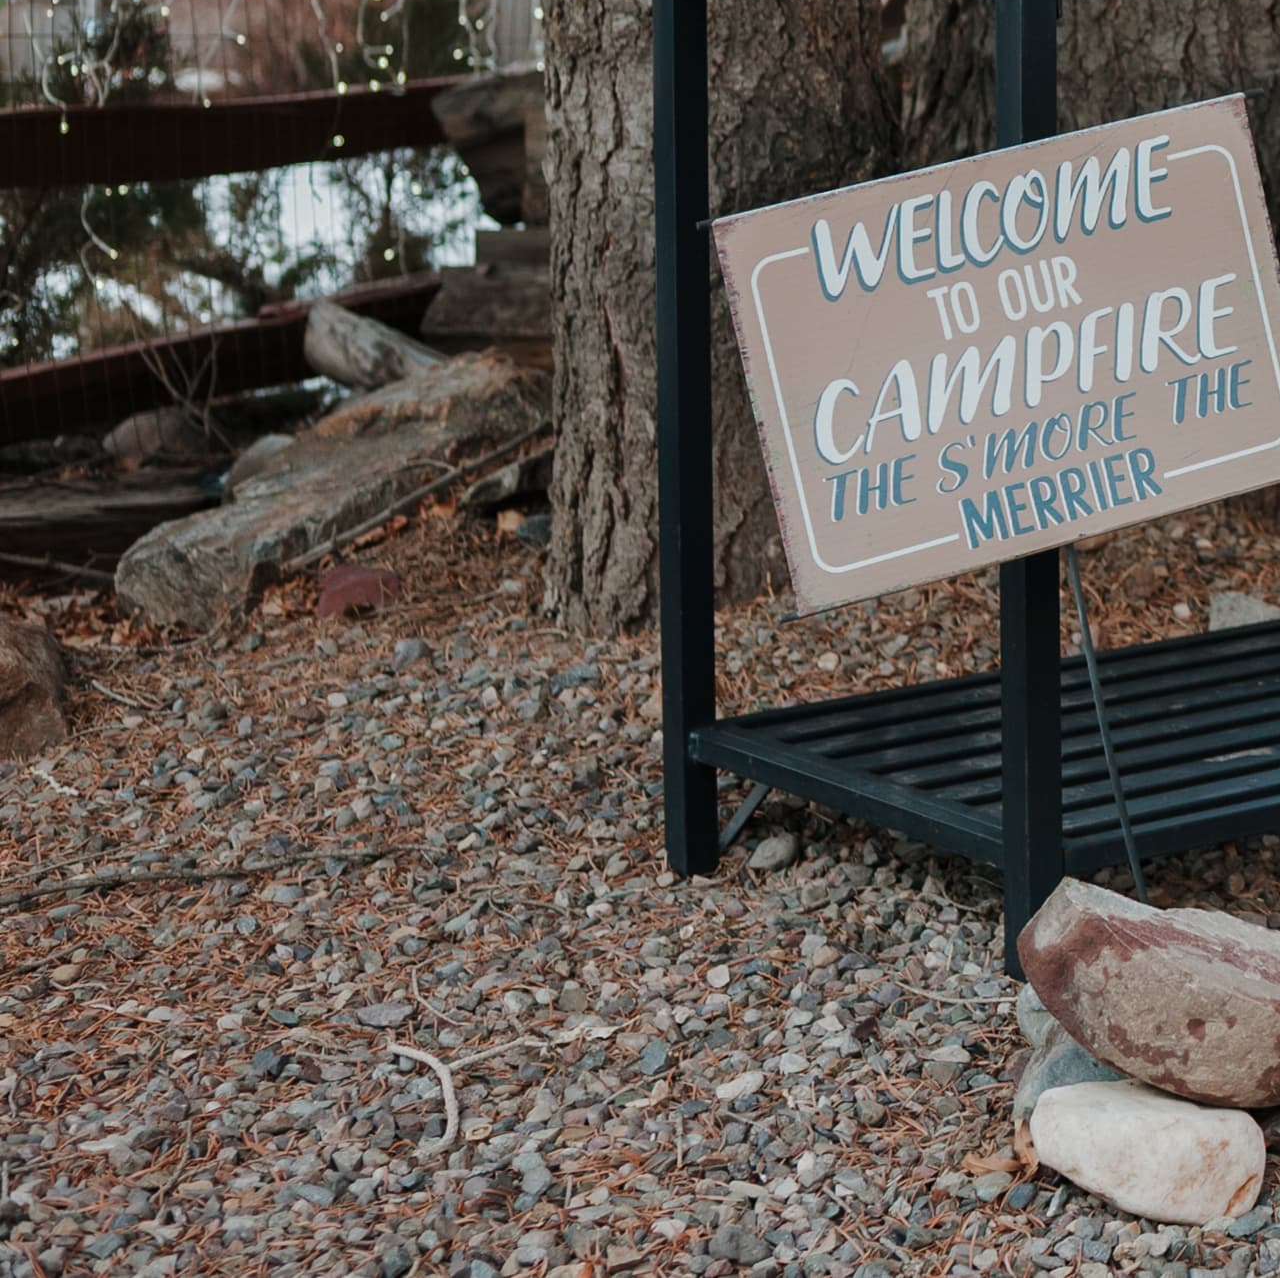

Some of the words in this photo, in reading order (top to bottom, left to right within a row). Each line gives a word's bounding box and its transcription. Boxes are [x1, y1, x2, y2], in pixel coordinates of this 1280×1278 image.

[811, 134, 1172, 301] WELCOME
[927, 281, 981, 340] TO
[999, 256, 1083, 321] OUR
[813, 272, 1239, 465] CAMPFIRE
[822, 454, 919, 522] THE
[936, 391, 1138, 495] S'MORE
[1165, 359, 1254, 425] THE
[957, 446, 1164, 550] MERRIER
